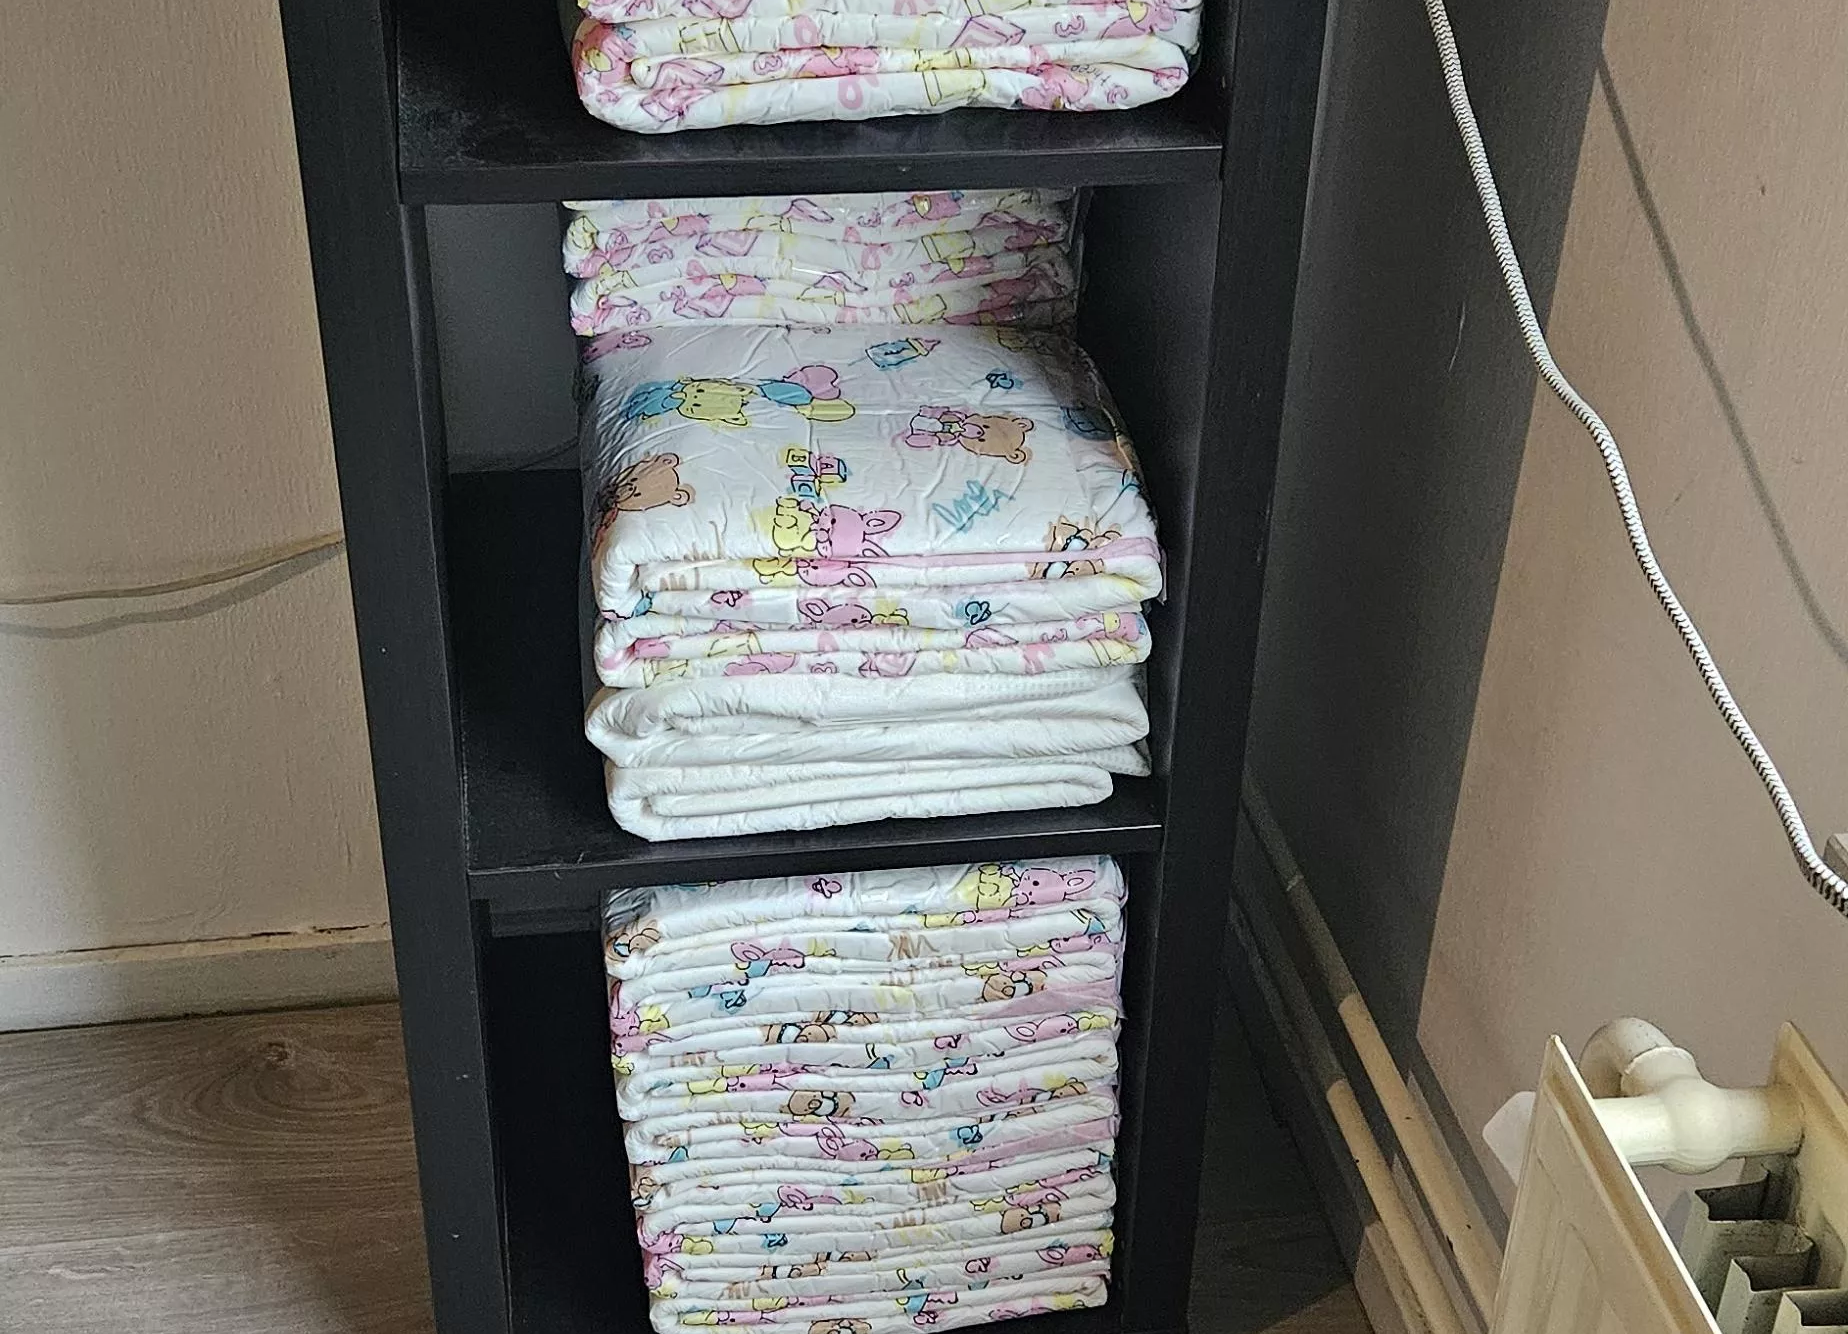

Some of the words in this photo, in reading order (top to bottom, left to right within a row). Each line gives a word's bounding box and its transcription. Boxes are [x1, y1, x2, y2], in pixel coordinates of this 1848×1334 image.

[791, 454, 807, 463] B
[820, 462, 834, 471] A
[798, 482, 813, 492] C
